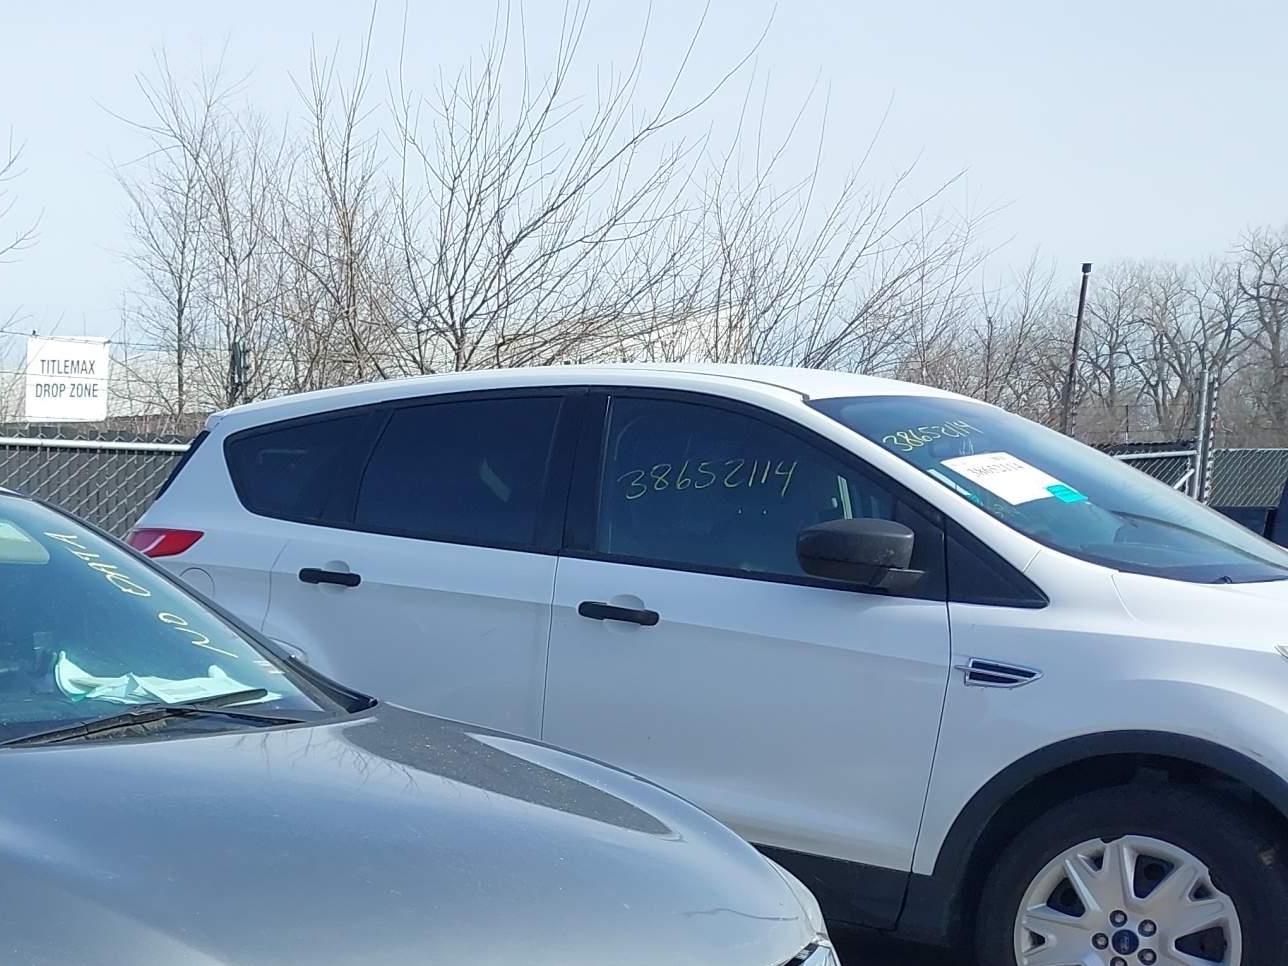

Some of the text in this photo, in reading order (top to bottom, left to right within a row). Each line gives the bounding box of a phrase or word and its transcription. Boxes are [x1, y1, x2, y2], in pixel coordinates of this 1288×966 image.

[40, 360, 96, 374] TITLEMAX
[35, 383, 98, 398] DROP ZONE
[616, 459, 798, 500] 38652114
